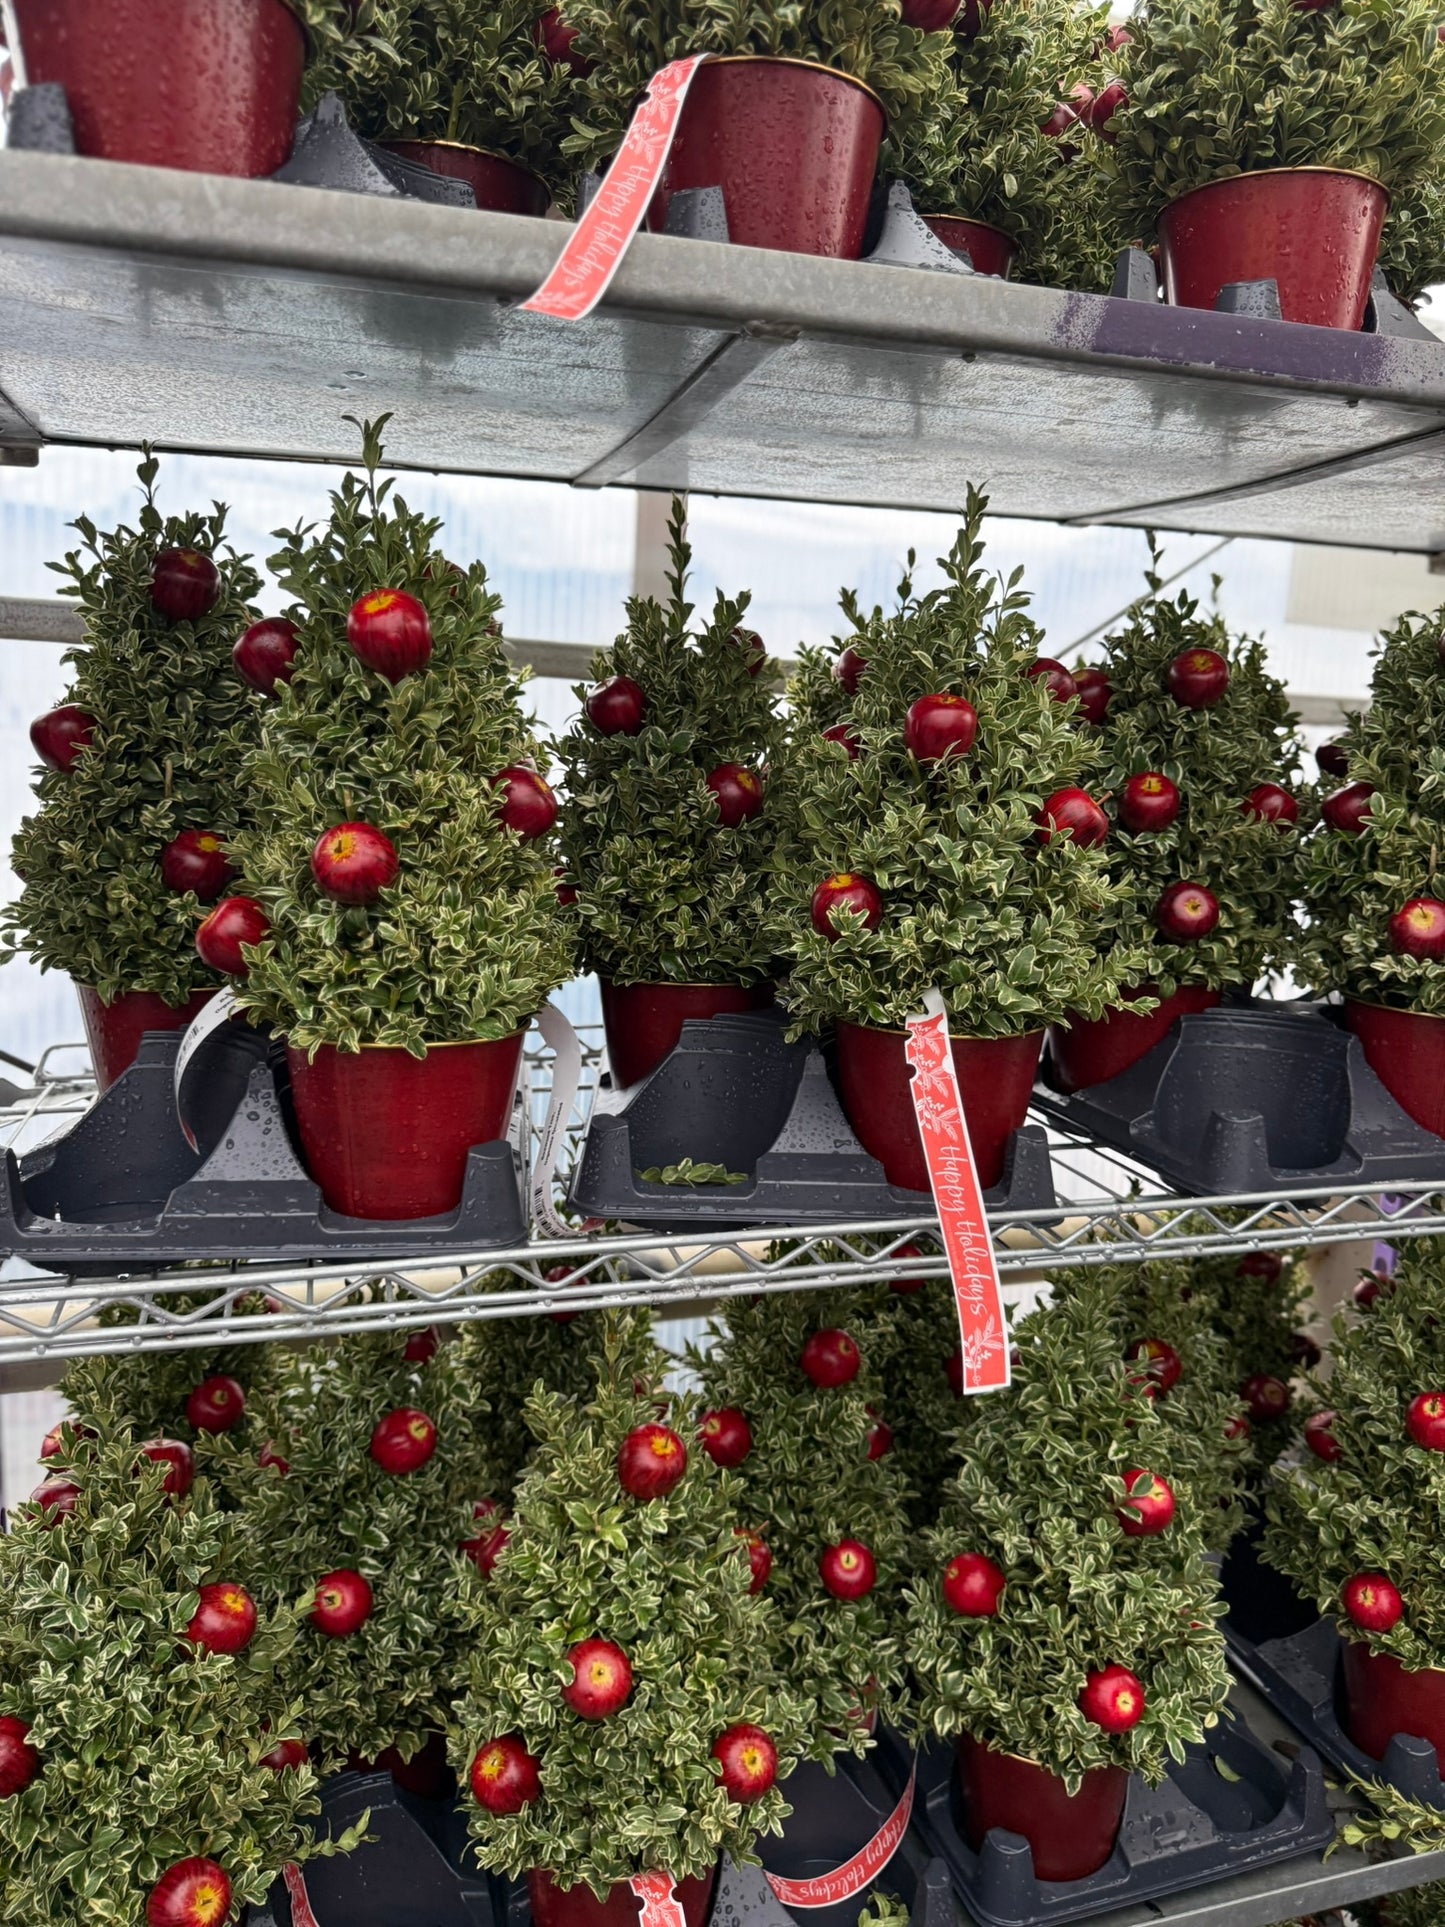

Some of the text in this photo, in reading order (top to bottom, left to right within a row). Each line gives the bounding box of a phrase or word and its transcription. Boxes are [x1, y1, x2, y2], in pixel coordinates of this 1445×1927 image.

[562, 165, 650, 289] Happy Holidays
[935, 1145, 968, 1218] Happy
[954, 1220, 991, 1317] Holidays
[800, 1820, 902, 1900] Happy Holidays
